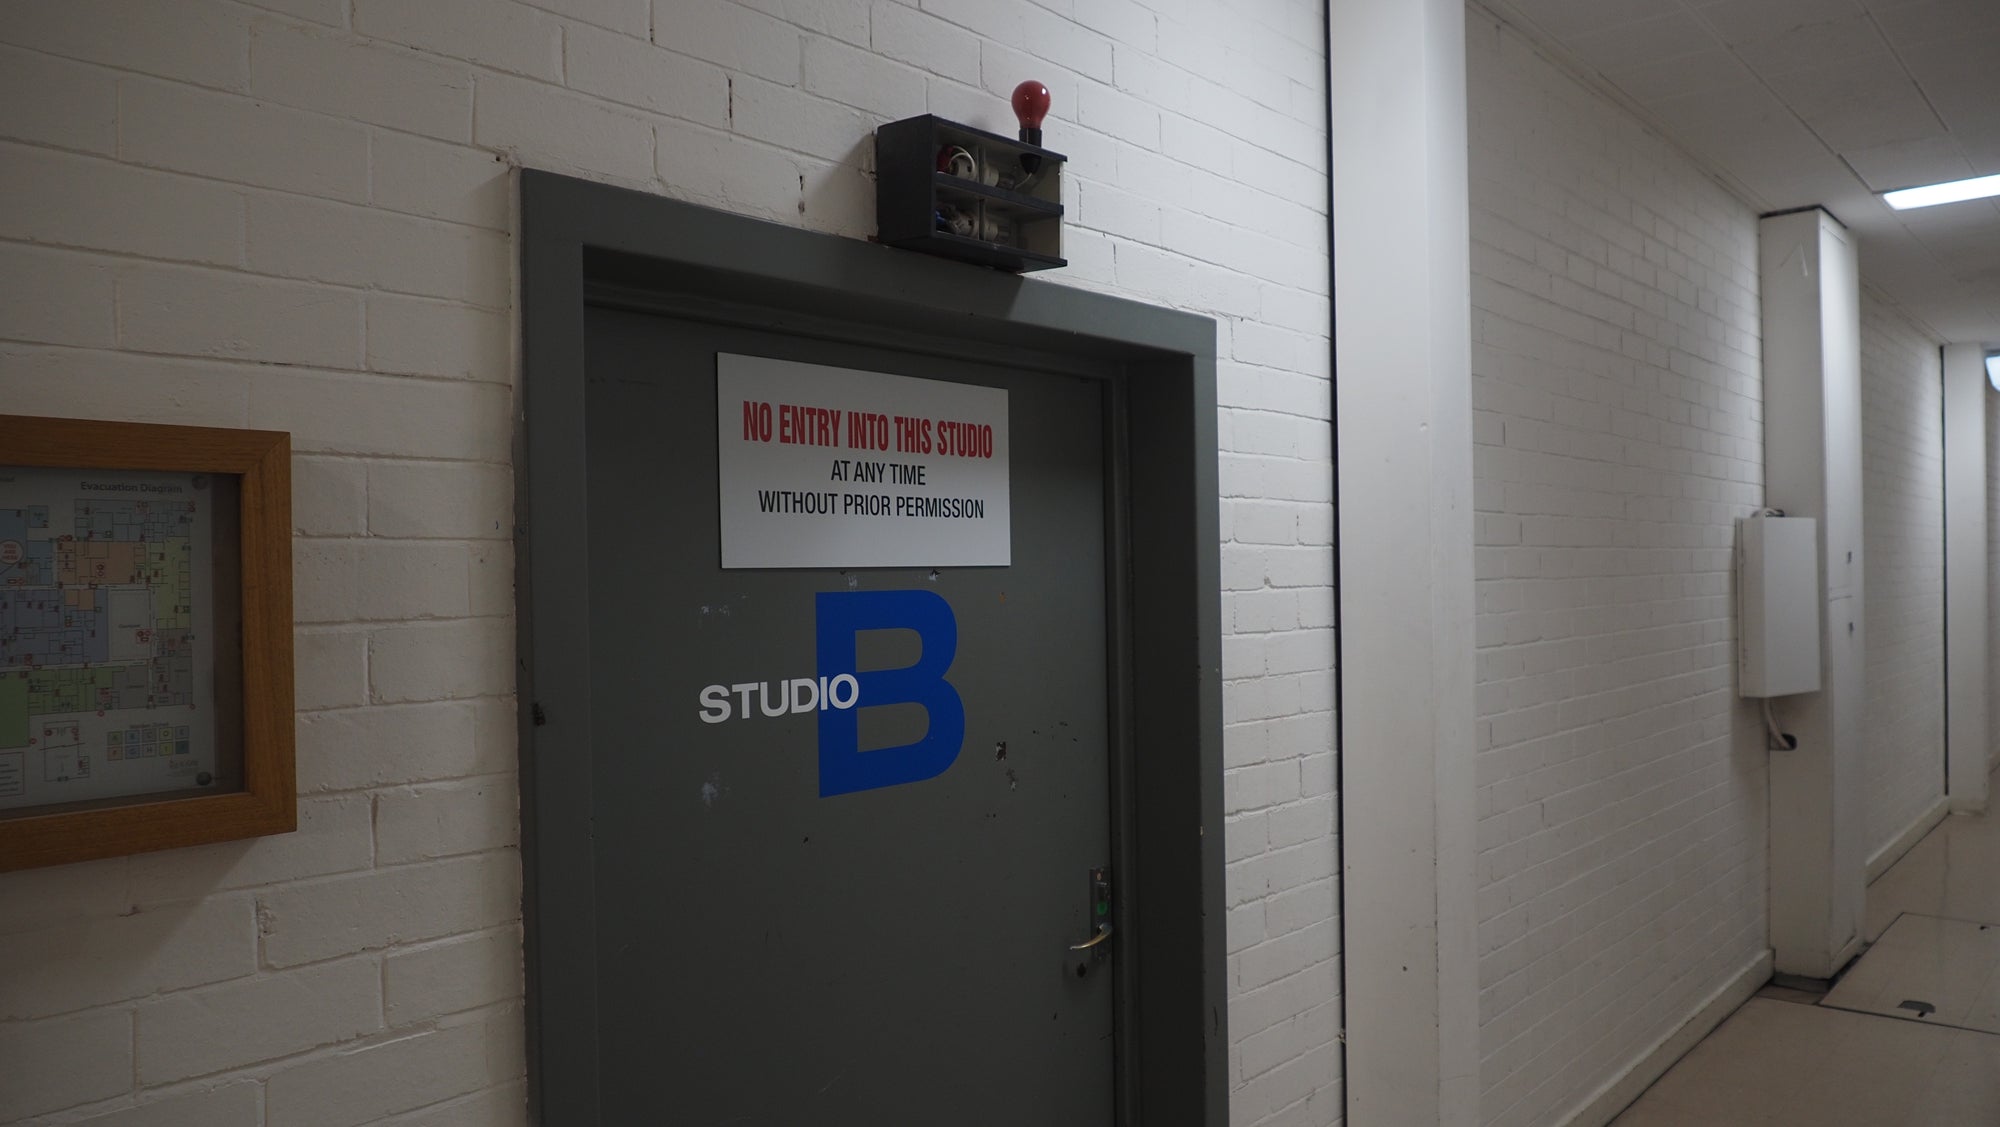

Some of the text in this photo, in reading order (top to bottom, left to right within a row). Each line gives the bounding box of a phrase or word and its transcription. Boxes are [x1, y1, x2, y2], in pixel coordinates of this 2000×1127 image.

[743, 400, 993, 459] NO ENTRY INTO THIS STUDIO
[830, 459, 926, 486] AT ANY TIME
[80, 481, 182, 494] Evacuation Diagram
[758, 490, 984, 519] WITHOUT PRIOR PERMISSION
[698, 590, 965, 798] STUDIO B
